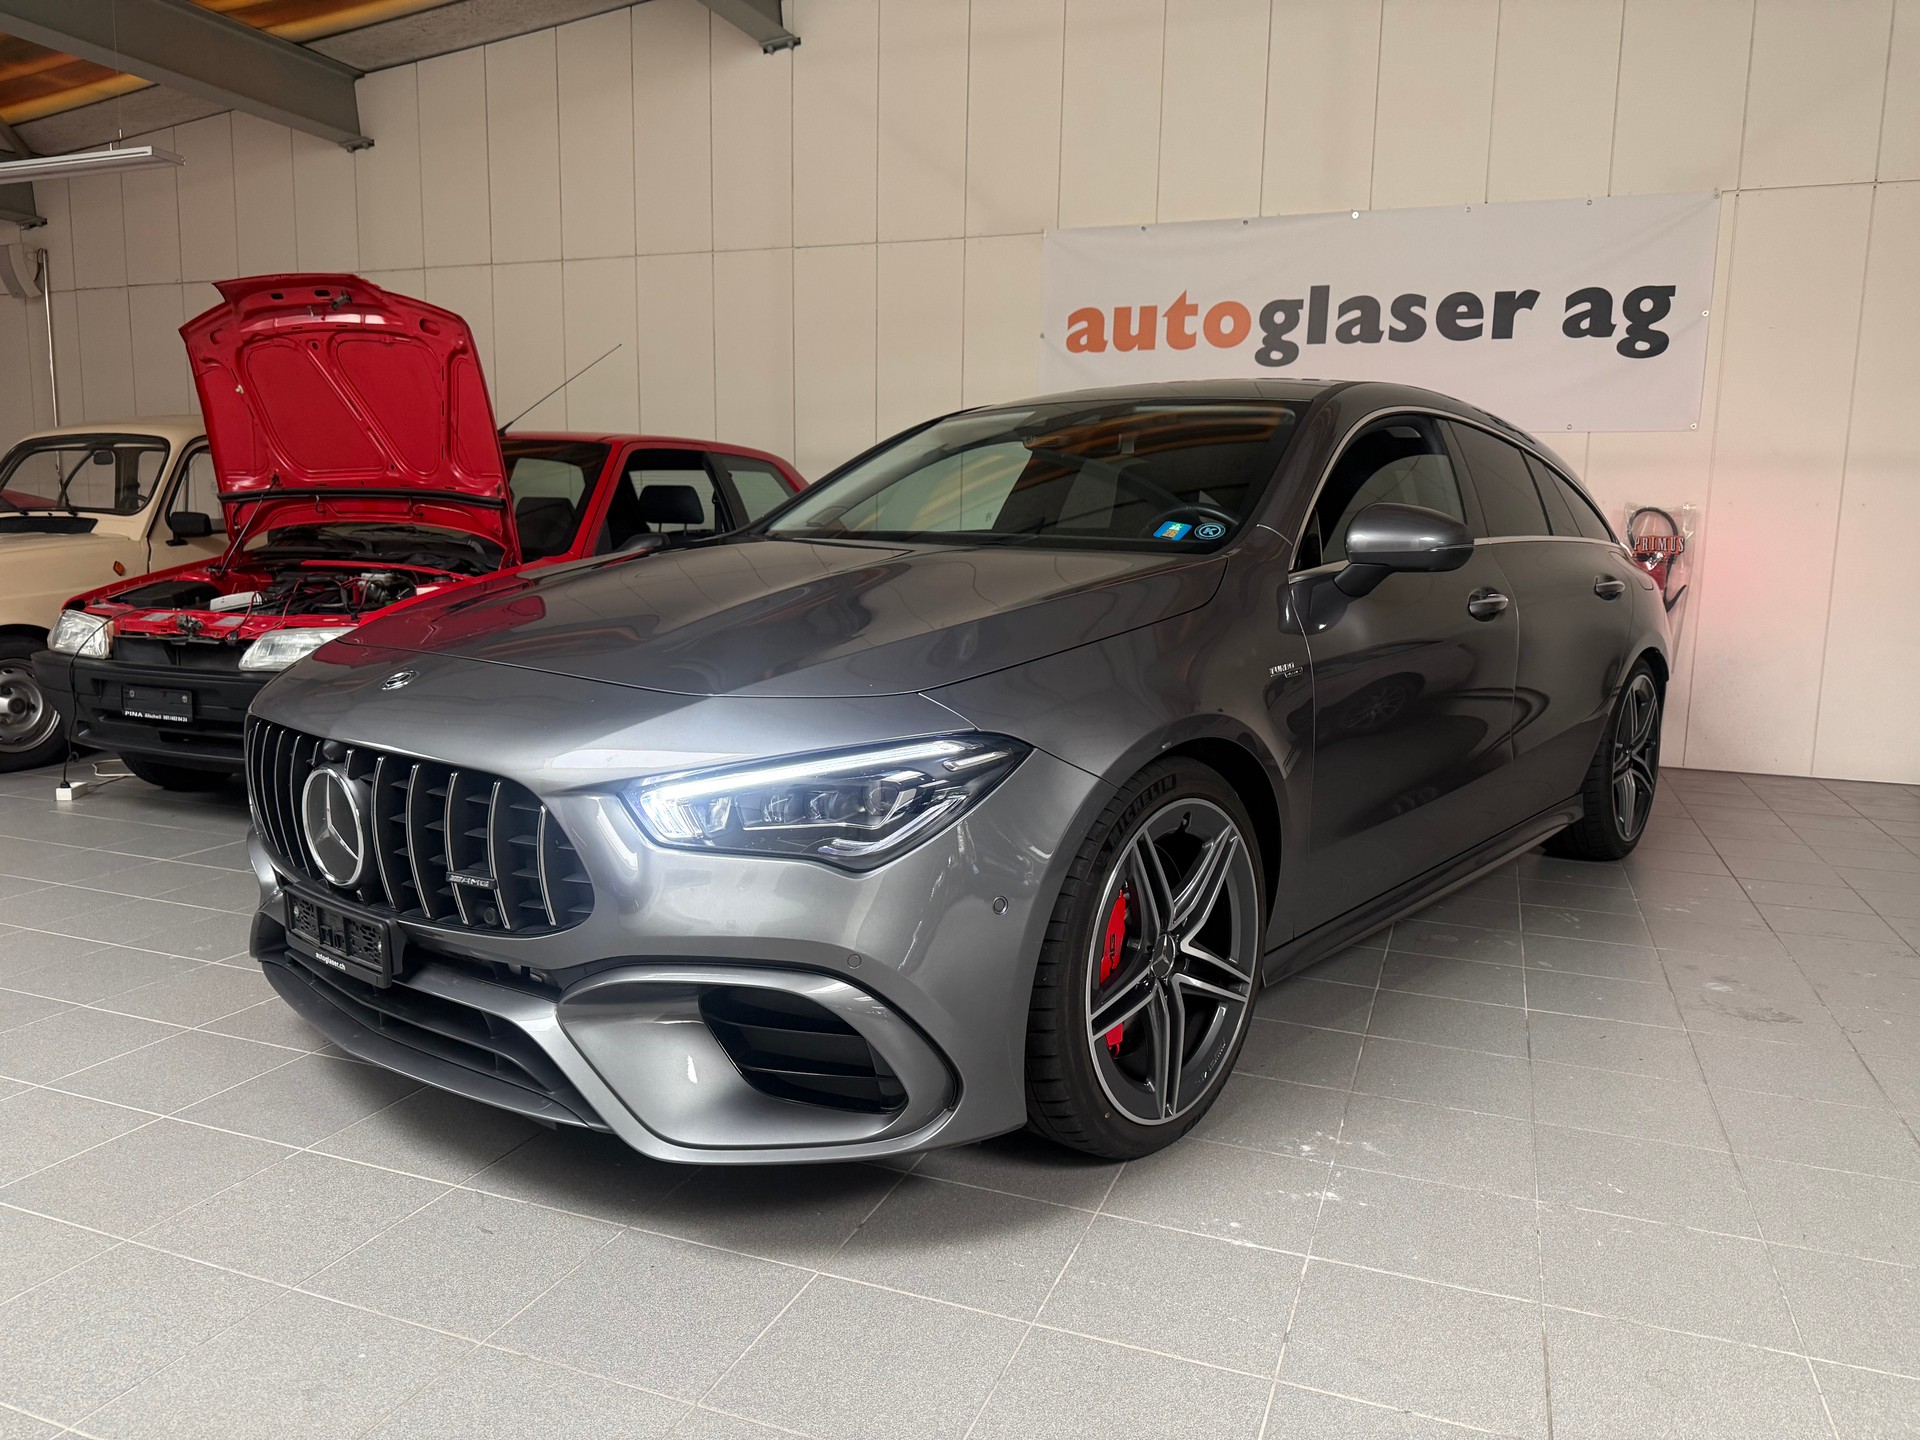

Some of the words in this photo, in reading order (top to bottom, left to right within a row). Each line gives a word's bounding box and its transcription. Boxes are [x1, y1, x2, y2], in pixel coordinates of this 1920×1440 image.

[1064, 284, 1541, 368] autoglaser
[1561, 284, 1677, 360] ag
[1633, 536, 1685, 553] PRIMUS
[1269, 662, 1295, 675] TURBO
[1107, 773, 1178, 846] MICHELIN
